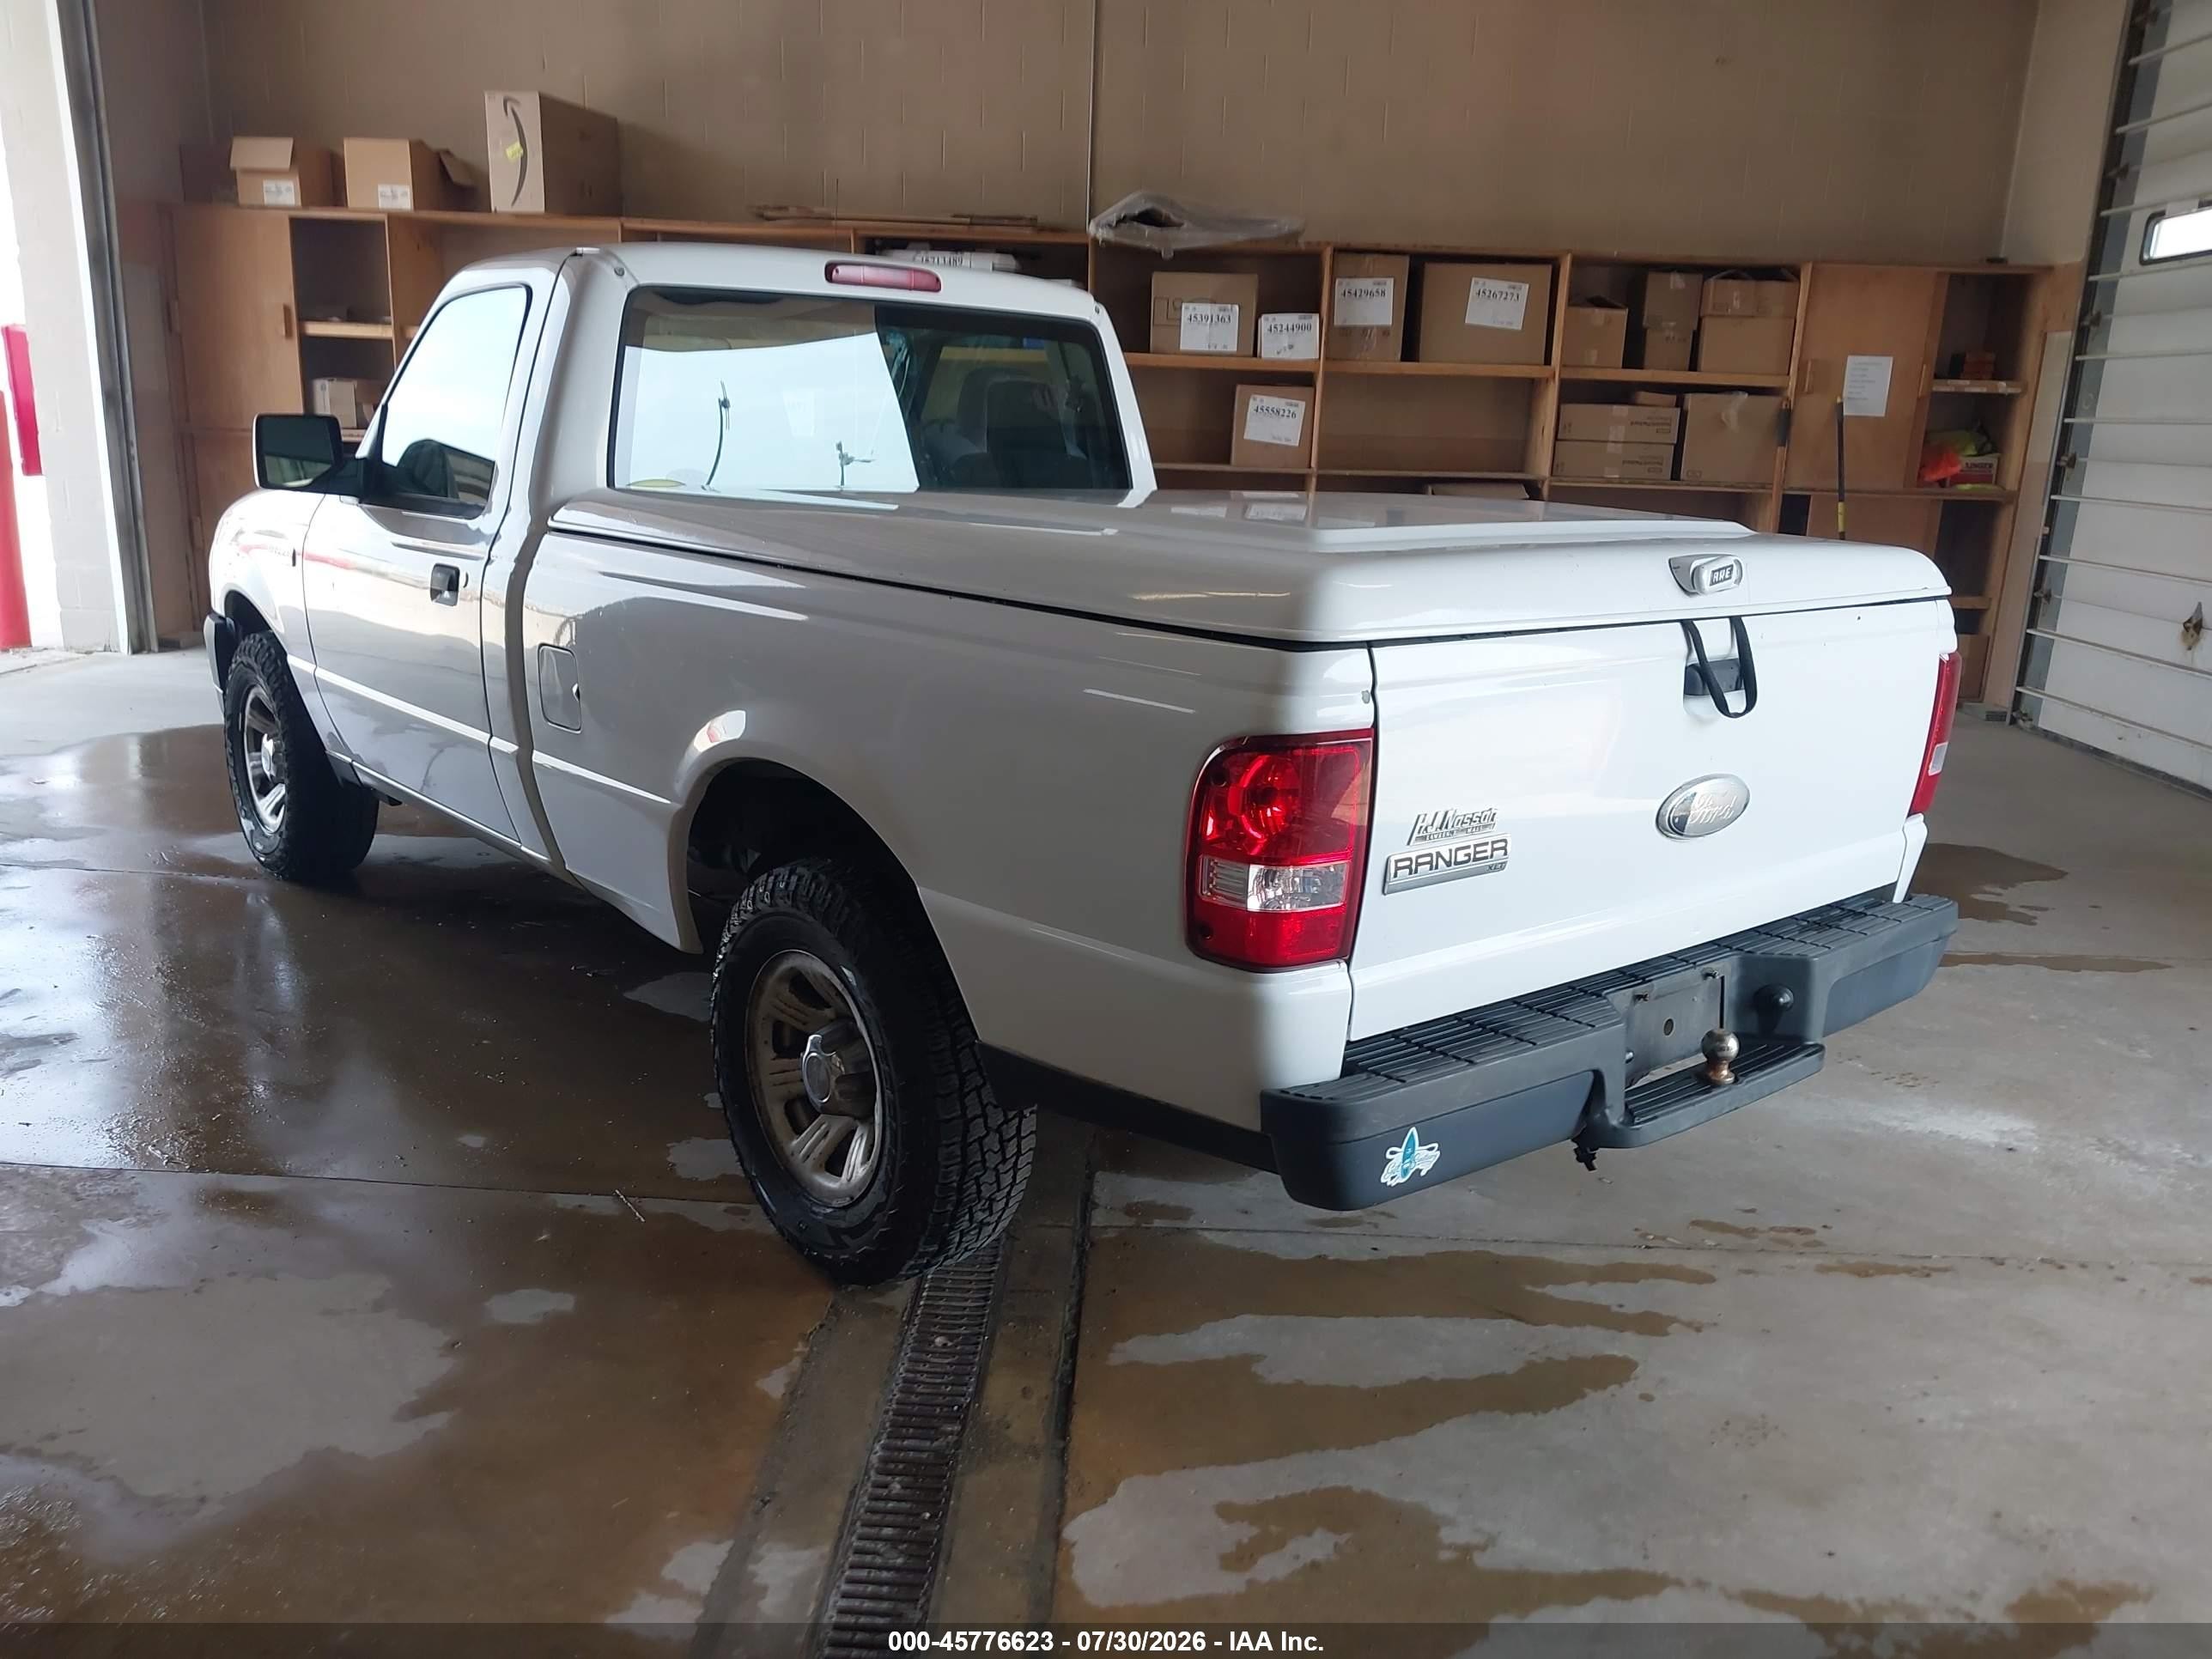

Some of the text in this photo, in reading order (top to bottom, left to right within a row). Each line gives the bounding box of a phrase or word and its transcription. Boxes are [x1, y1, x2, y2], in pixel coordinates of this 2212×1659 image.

[1340, 288, 1386, 299] 45429658
[1475, 288, 1520, 301] 45267273
[1187, 313, 1232, 325] 45391363
[1267, 322, 1312, 334] 45244900
[1254, 404, 1297, 419] 45558226
[1689, 793, 1738, 825] Ford
[1393, 838, 1509, 878] RANGER
